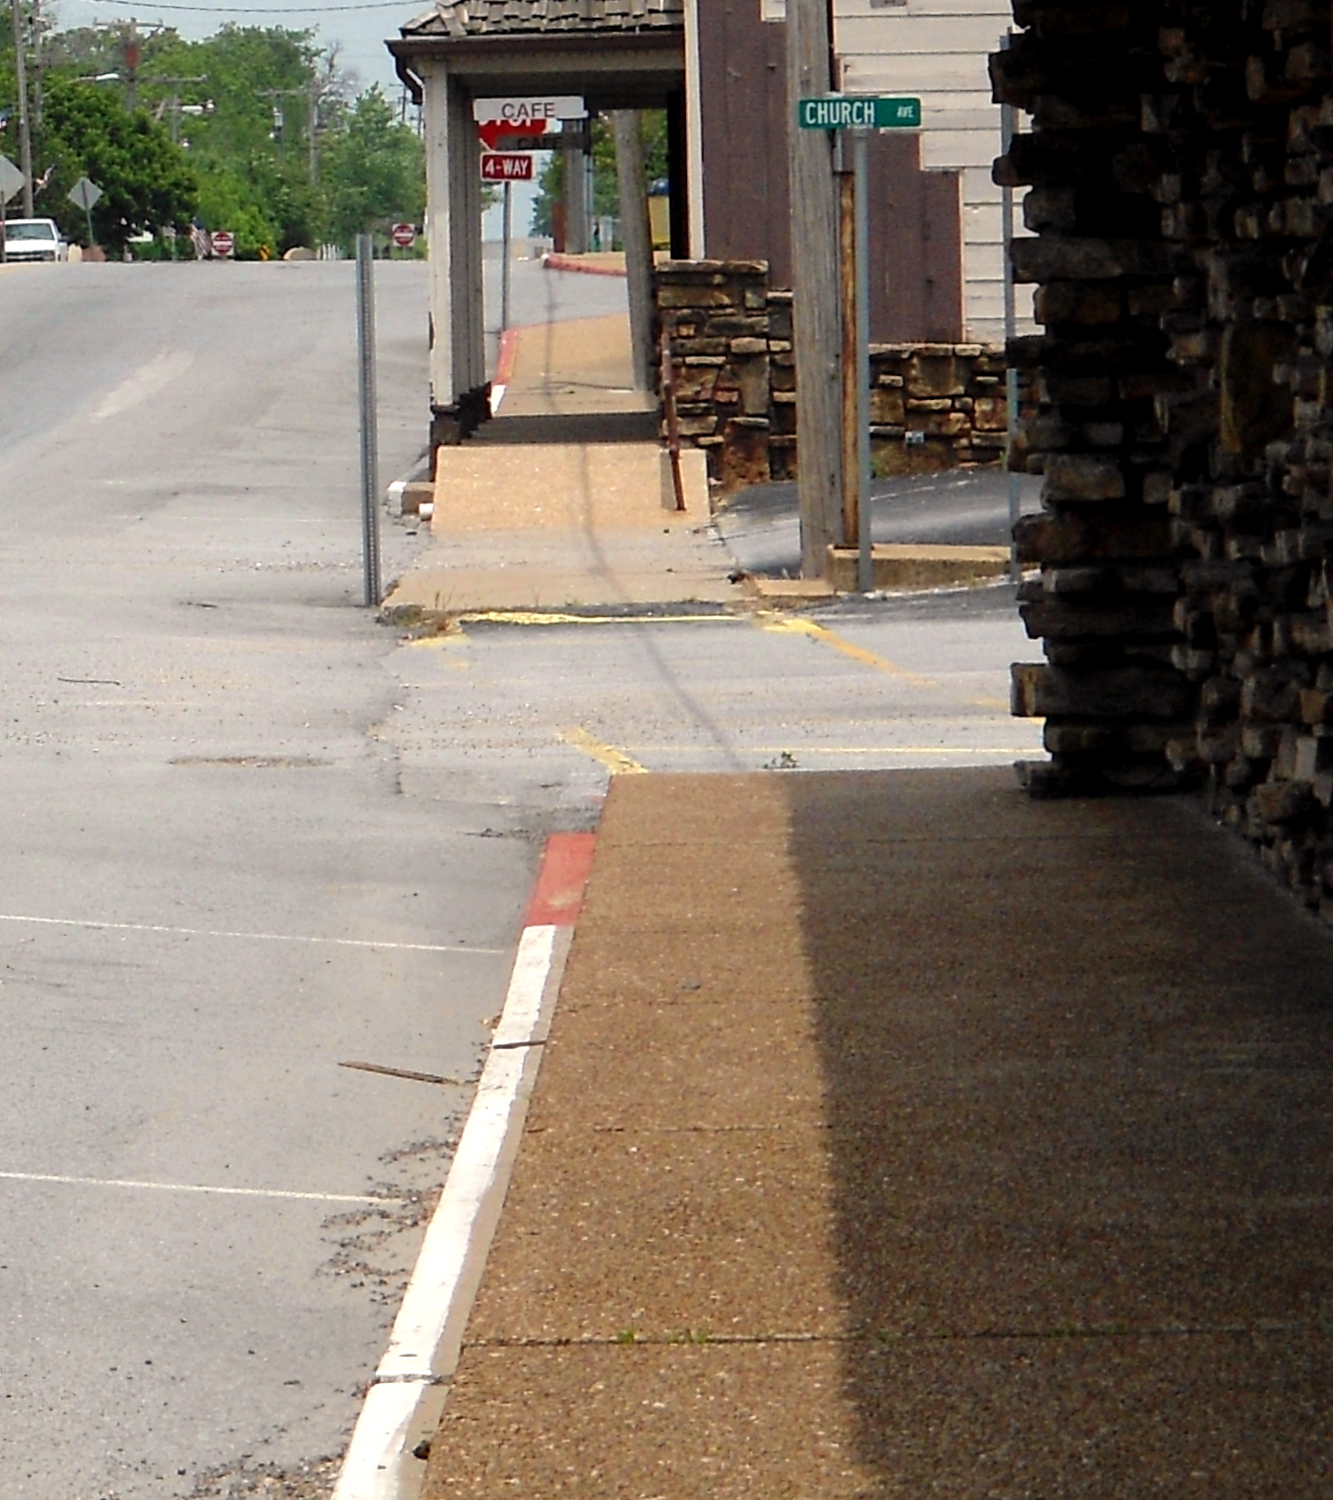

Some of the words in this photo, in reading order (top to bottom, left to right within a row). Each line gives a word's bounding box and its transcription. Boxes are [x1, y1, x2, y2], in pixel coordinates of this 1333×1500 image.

[501, 102, 555, 118] CAFE
[805, 101, 875, 125] CHURCH
[896, 105, 914, 118] AVE
[485, 158, 529, 176] 4-WAY
